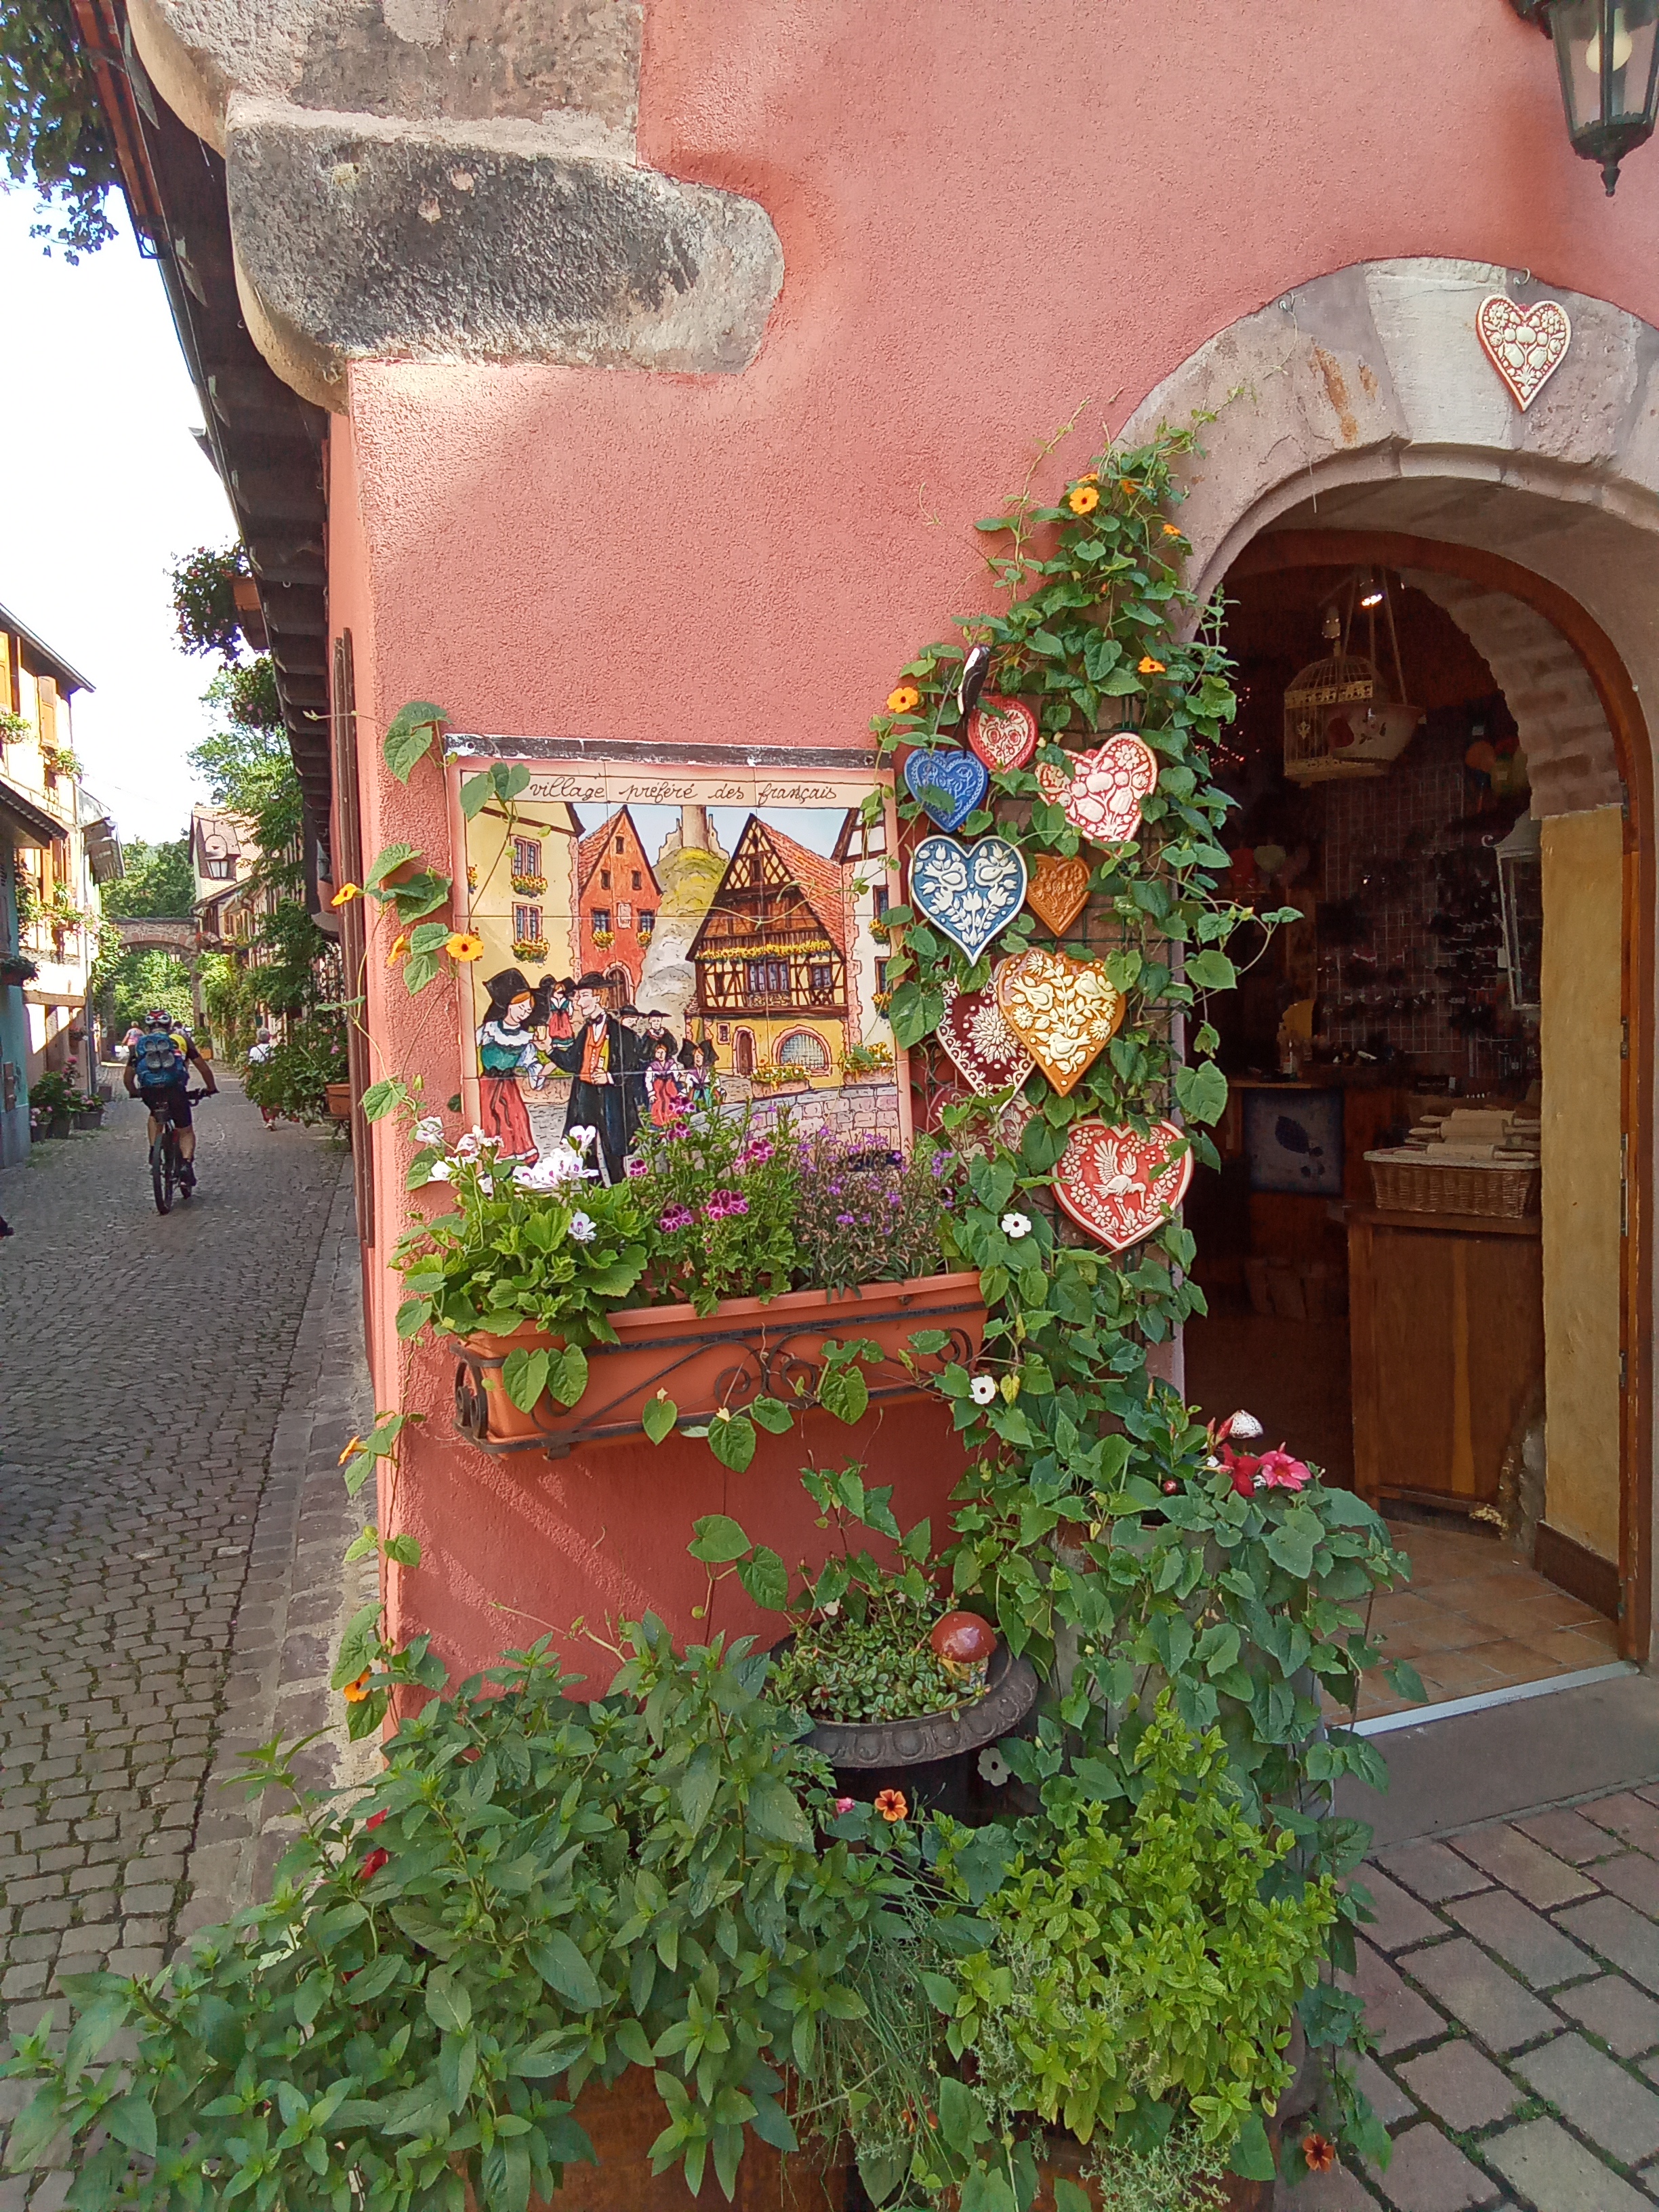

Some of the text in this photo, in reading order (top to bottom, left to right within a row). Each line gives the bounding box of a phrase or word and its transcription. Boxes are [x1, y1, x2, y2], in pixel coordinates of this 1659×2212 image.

[529, 777, 837, 805] village préféré des français
